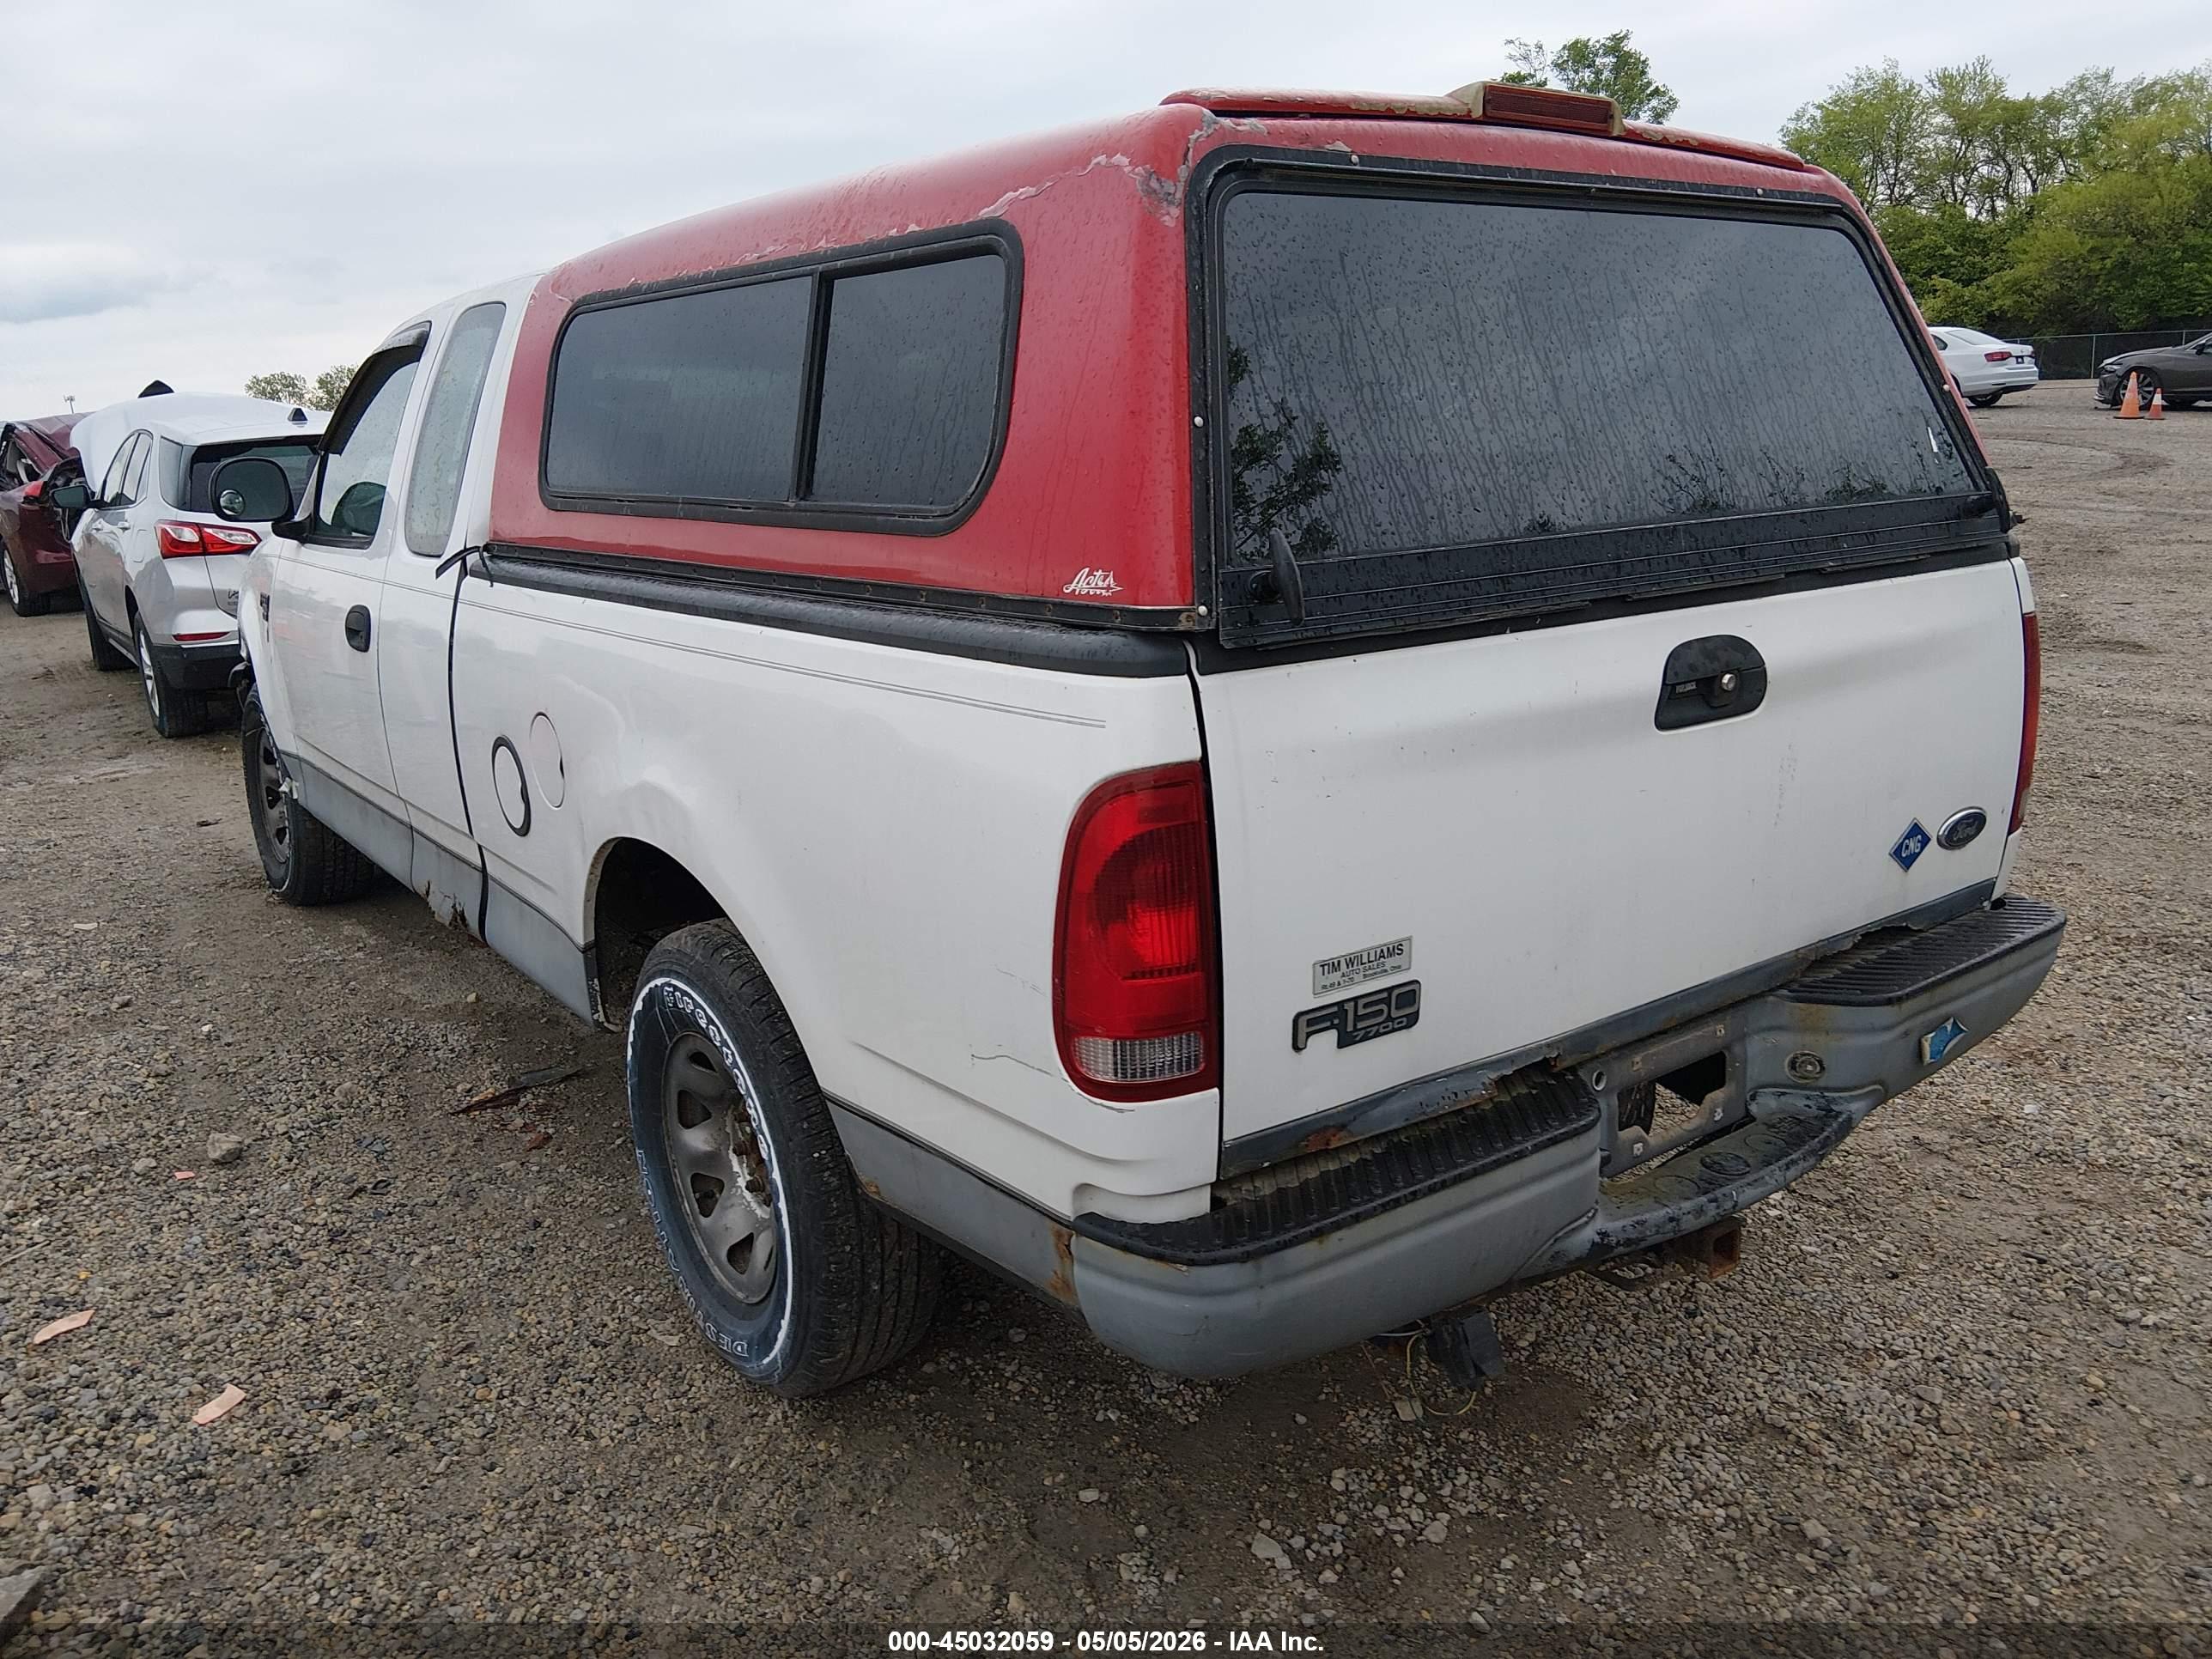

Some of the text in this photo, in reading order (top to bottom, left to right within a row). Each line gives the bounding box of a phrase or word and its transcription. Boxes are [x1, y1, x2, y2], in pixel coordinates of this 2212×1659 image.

[1901, 834, 1923, 858] CNG
[1320, 943, 1405, 976] TIM WILLIAMS
[1340, 961, 1387, 979] AUTO SALES
[1352, 1017, 1407, 1040] 7700
[662, 986, 769, 1160] Firestone
